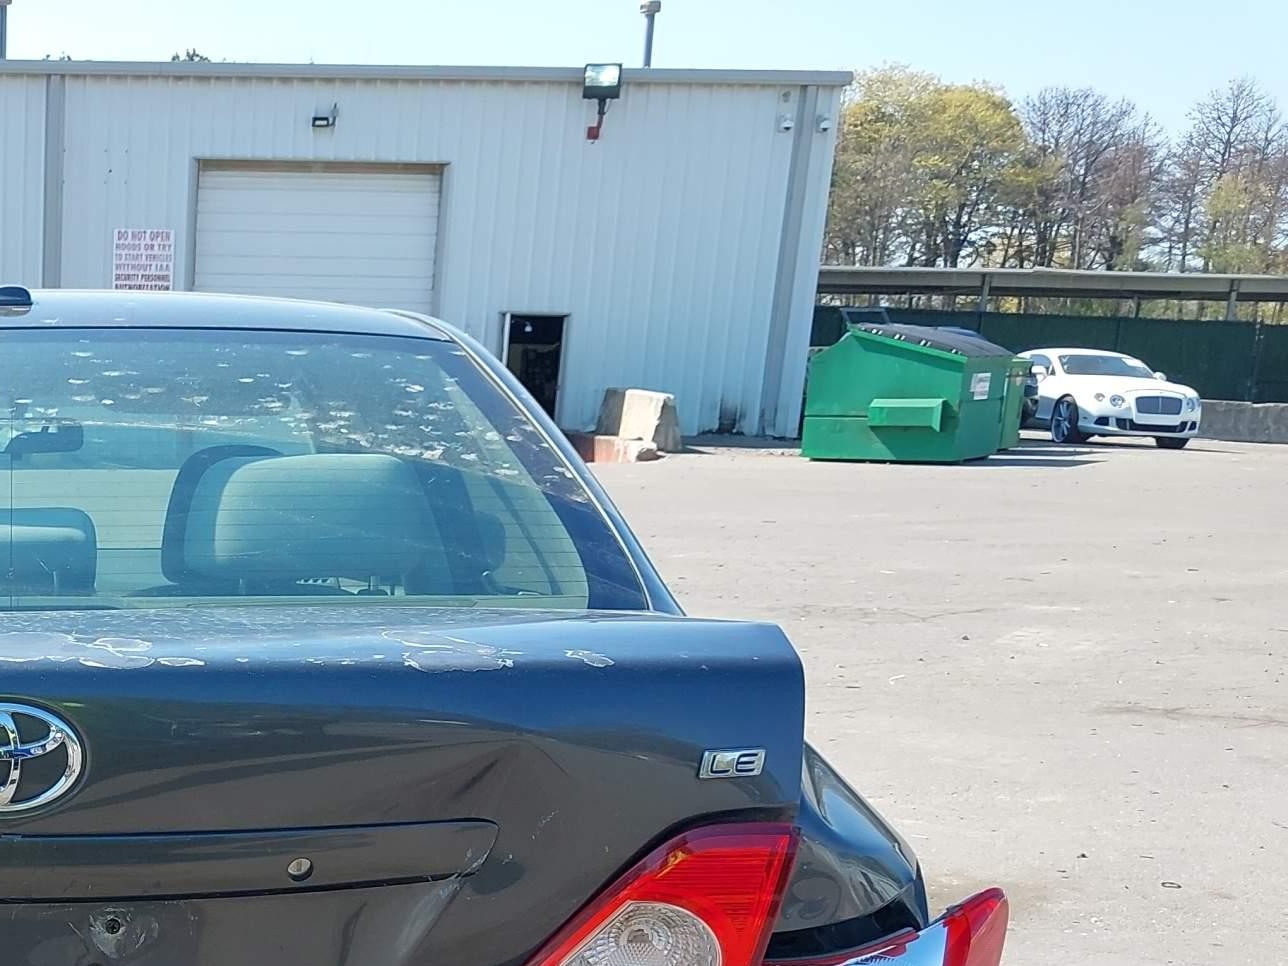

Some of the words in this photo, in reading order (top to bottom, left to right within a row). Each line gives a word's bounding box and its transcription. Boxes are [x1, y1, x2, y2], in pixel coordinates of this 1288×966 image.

[117, 230, 129, 241] DO
[131, 230, 147, 241] NOT
[149, 230, 171, 242] OPEN
[115, 243, 141, 252] HOODS
[143, 243, 155, 252] OR
[158, 243, 172, 252] TRY
[115, 253, 123, 262] TO
[124, 253, 143, 262] START
[145, 253, 172, 263] VEHICLES
[115, 263, 153, 272] WITHOUT
[155, 263, 171, 272] IAA
[114, 273, 139, 282] SECURITY
[140, 273, 170, 283] PERSONNEL
[708, 751, 760, 775] LE
